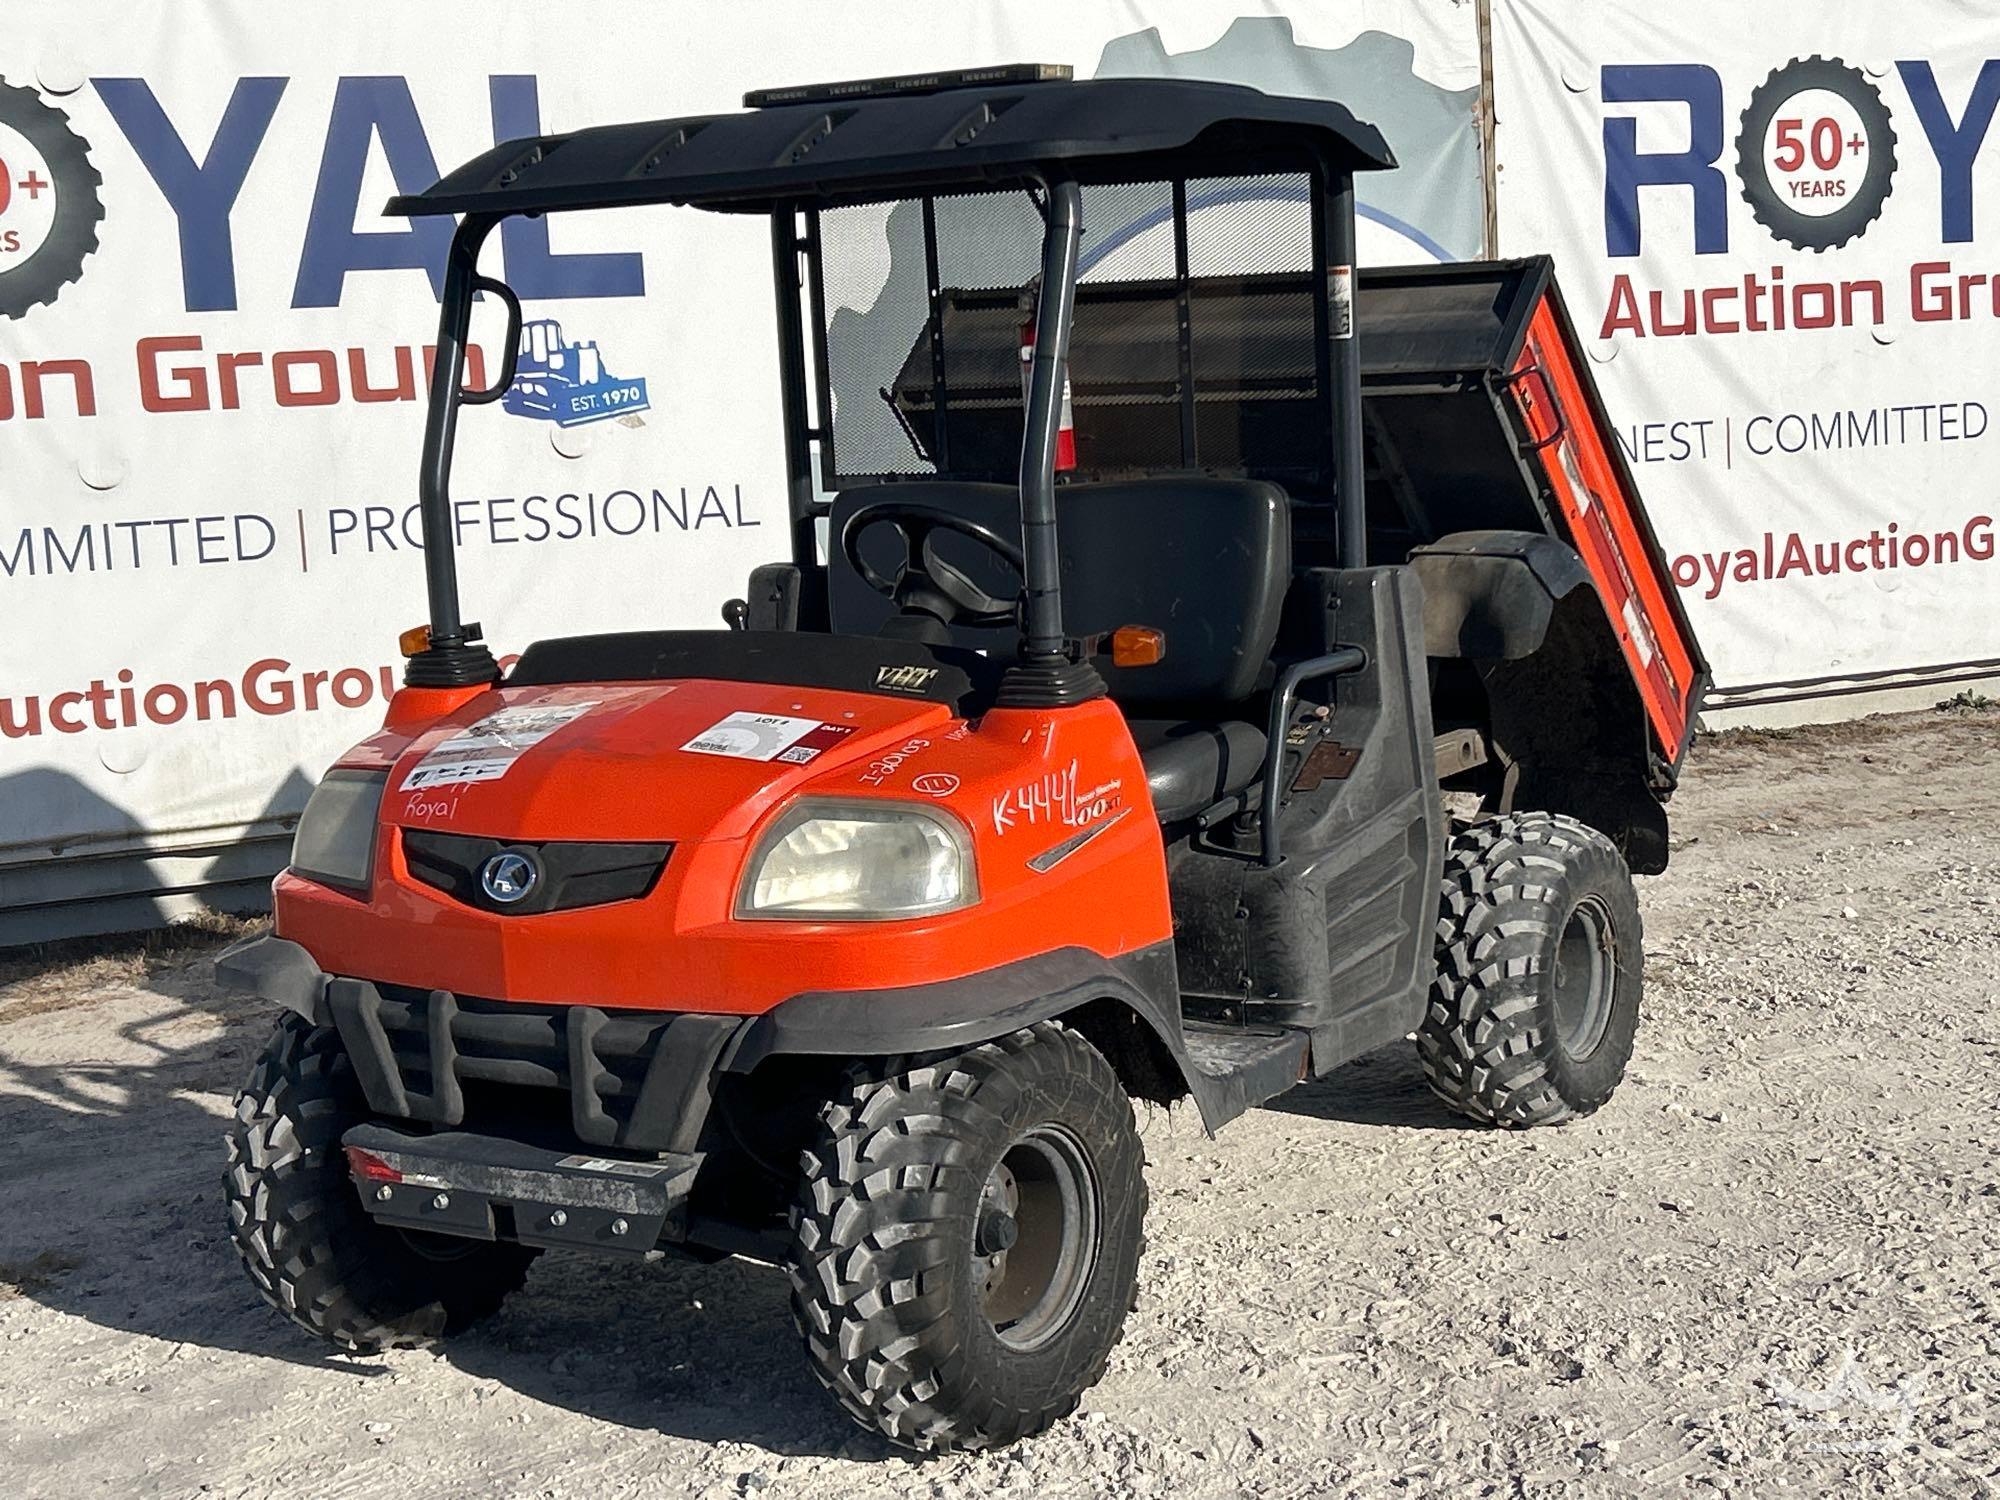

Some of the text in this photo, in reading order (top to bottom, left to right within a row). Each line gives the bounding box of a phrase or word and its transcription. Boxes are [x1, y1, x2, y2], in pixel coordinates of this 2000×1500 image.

[1774, 117, 1865, 172] 50+
[1788, 180, 1846, 199] YEARS
[1600, 261, 2000, 340] Auction Gr
[0, 357, 97, 420] n
[572, 386, 640, 412] EST. 1970
[1612, 402, 1988, 463] NEST COMMITTED
[0, 514, 276, 576] MMITTED
[1671, 515, 1995, 600] oyalAuctionG
[404, 792, 459, 824] Royal
